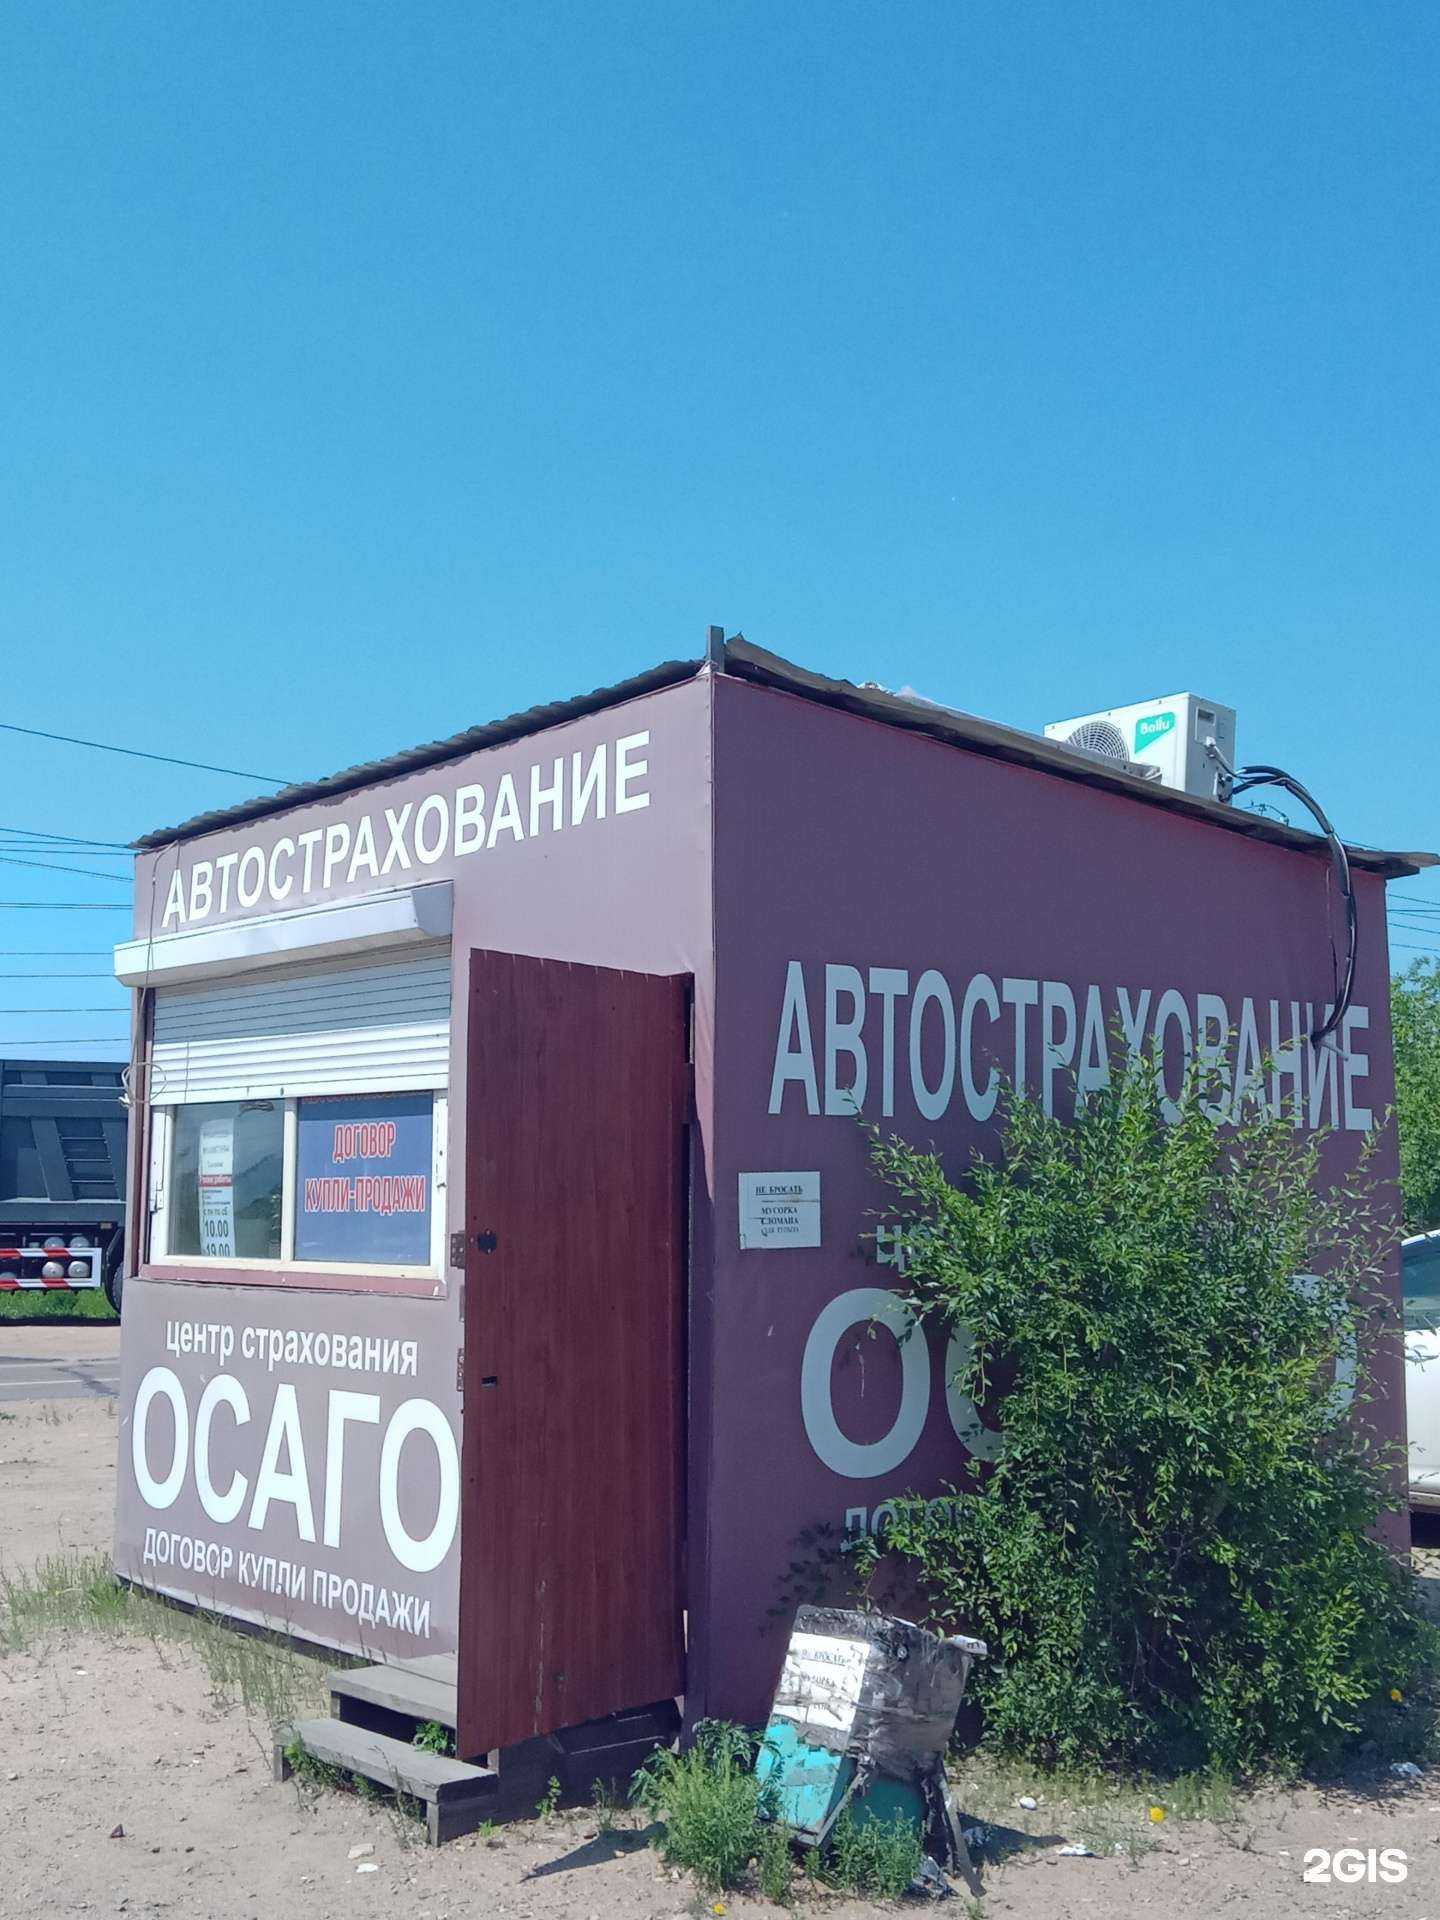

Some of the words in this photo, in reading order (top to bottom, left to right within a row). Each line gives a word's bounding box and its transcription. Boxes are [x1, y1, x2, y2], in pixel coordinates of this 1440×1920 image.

[1140, 719, 1171, 735] Ballu
[161, 730, 651, 928] АВТОСТРАХОВАНИЕ
[333, 1121, 396, 1163] ДОГОВОР
[304, 1175, 426, 1216] КУПЛИ-ПРОДАЖИ
[205, 1220, 229, 1238] 10.00
[166, 1320, 234, 1366] центр
[241, 1327, 418, 1376] страхования
[132, 1366, 459, 1573] ОСАГО
[143, 1527, 233, 1578] ДОГОВОР
[238, 1552, 306, 1602] КУПЛИ
[313, 1569, 431, 1639] ПРОДАЖИ
